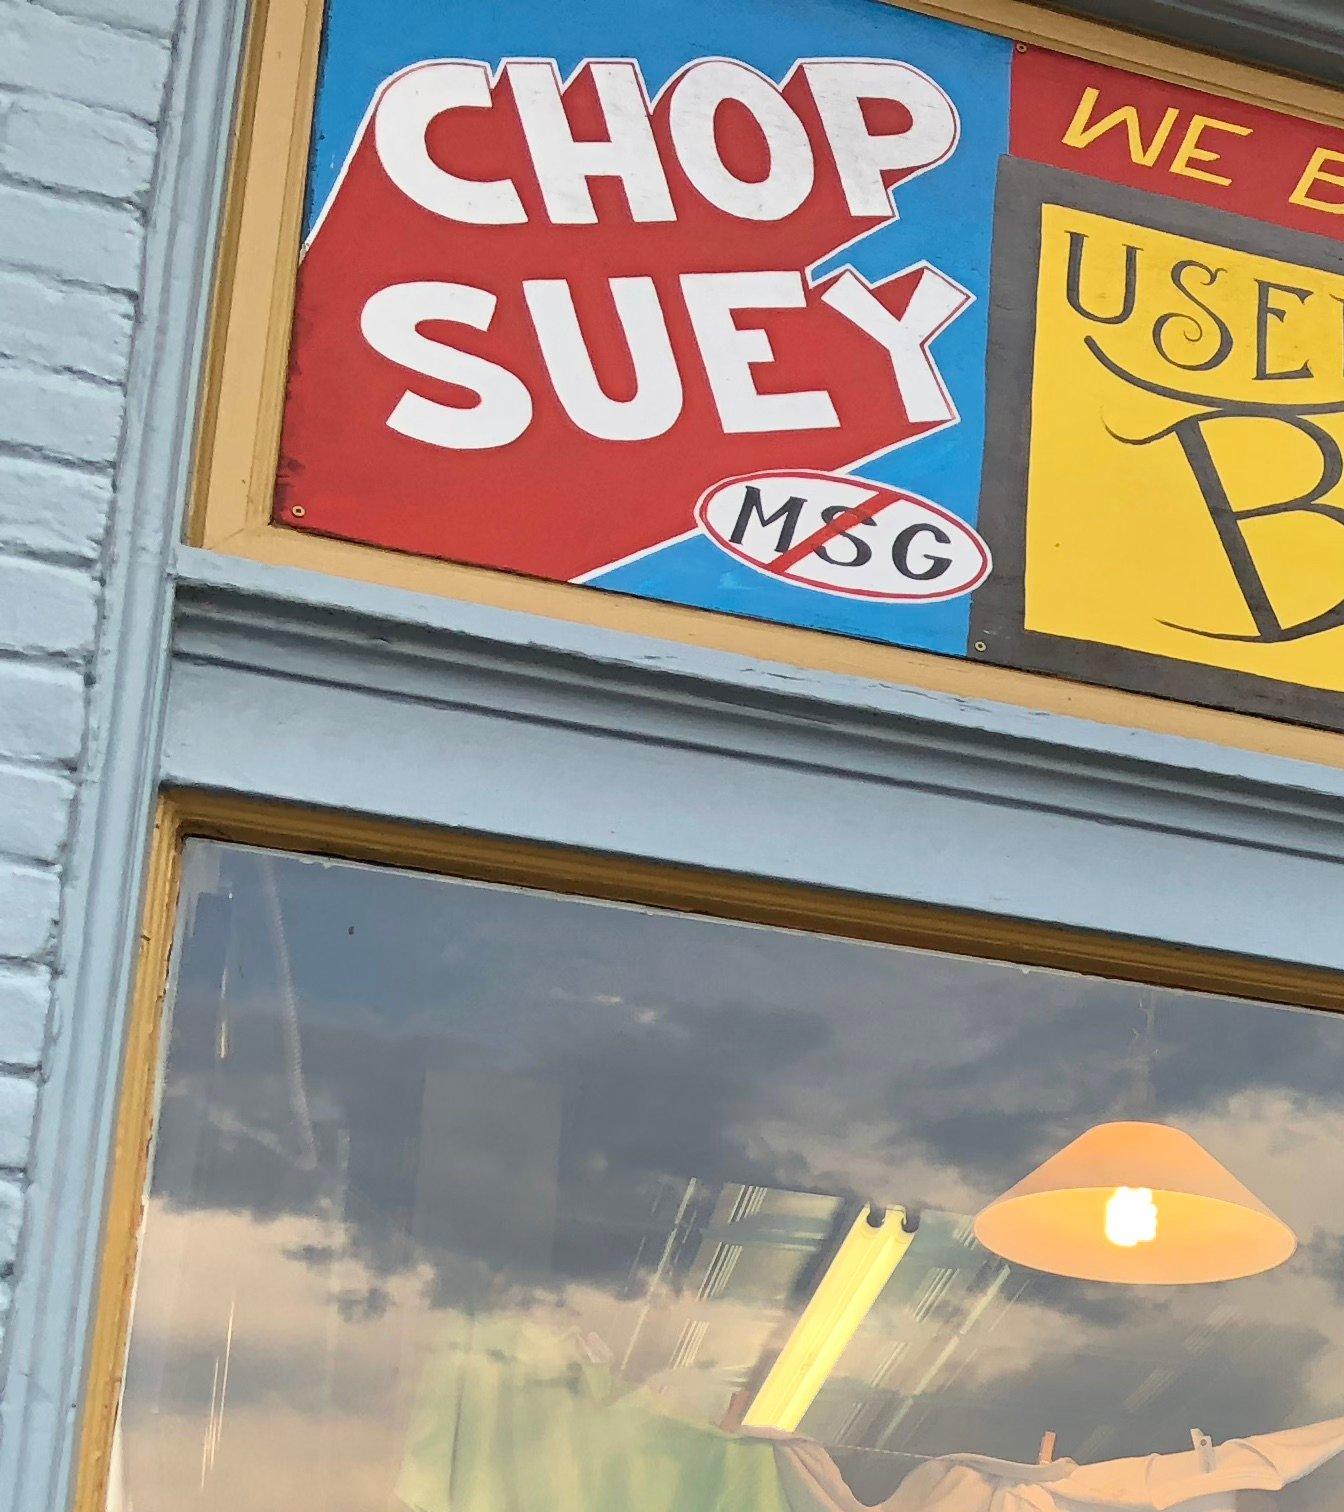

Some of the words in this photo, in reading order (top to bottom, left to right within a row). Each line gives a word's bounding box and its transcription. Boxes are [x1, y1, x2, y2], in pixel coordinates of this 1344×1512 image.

[374, 60, 957, 226] CHOP
[1061, 86, 1253, 187] WE
[360, 264, 972, 450] SUEY
[730, 485, 953, 582] MSG
